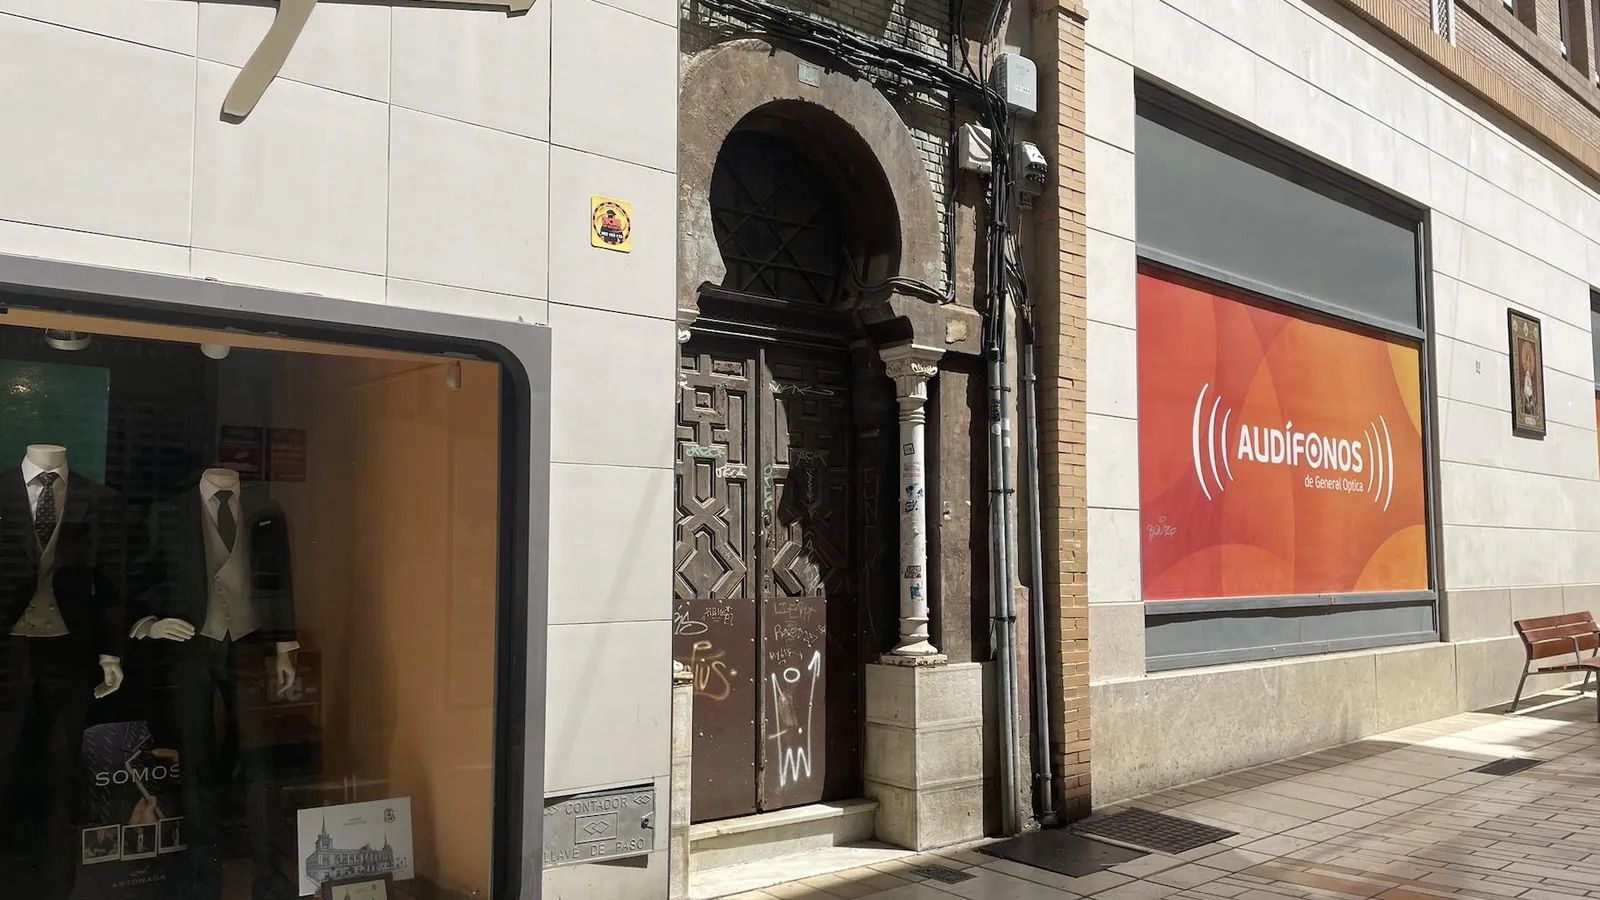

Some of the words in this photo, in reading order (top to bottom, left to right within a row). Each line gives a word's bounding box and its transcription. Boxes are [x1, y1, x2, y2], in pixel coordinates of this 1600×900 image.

[1237, 420, 1364, 473] AUDÍFONOS
[1304, 474, 1314, 488] de
[1315, 476, 1342, 490] General
[1342, 478, 1364, 493] Optica
[95, 763, 180, 787] SOMOS
[565, 797, 628, 815] CONTADOR
[543, 847, 580, 863] LLAVE
[590, 844, 606, 857] DE
[615, 838, 645, 853] PASO
